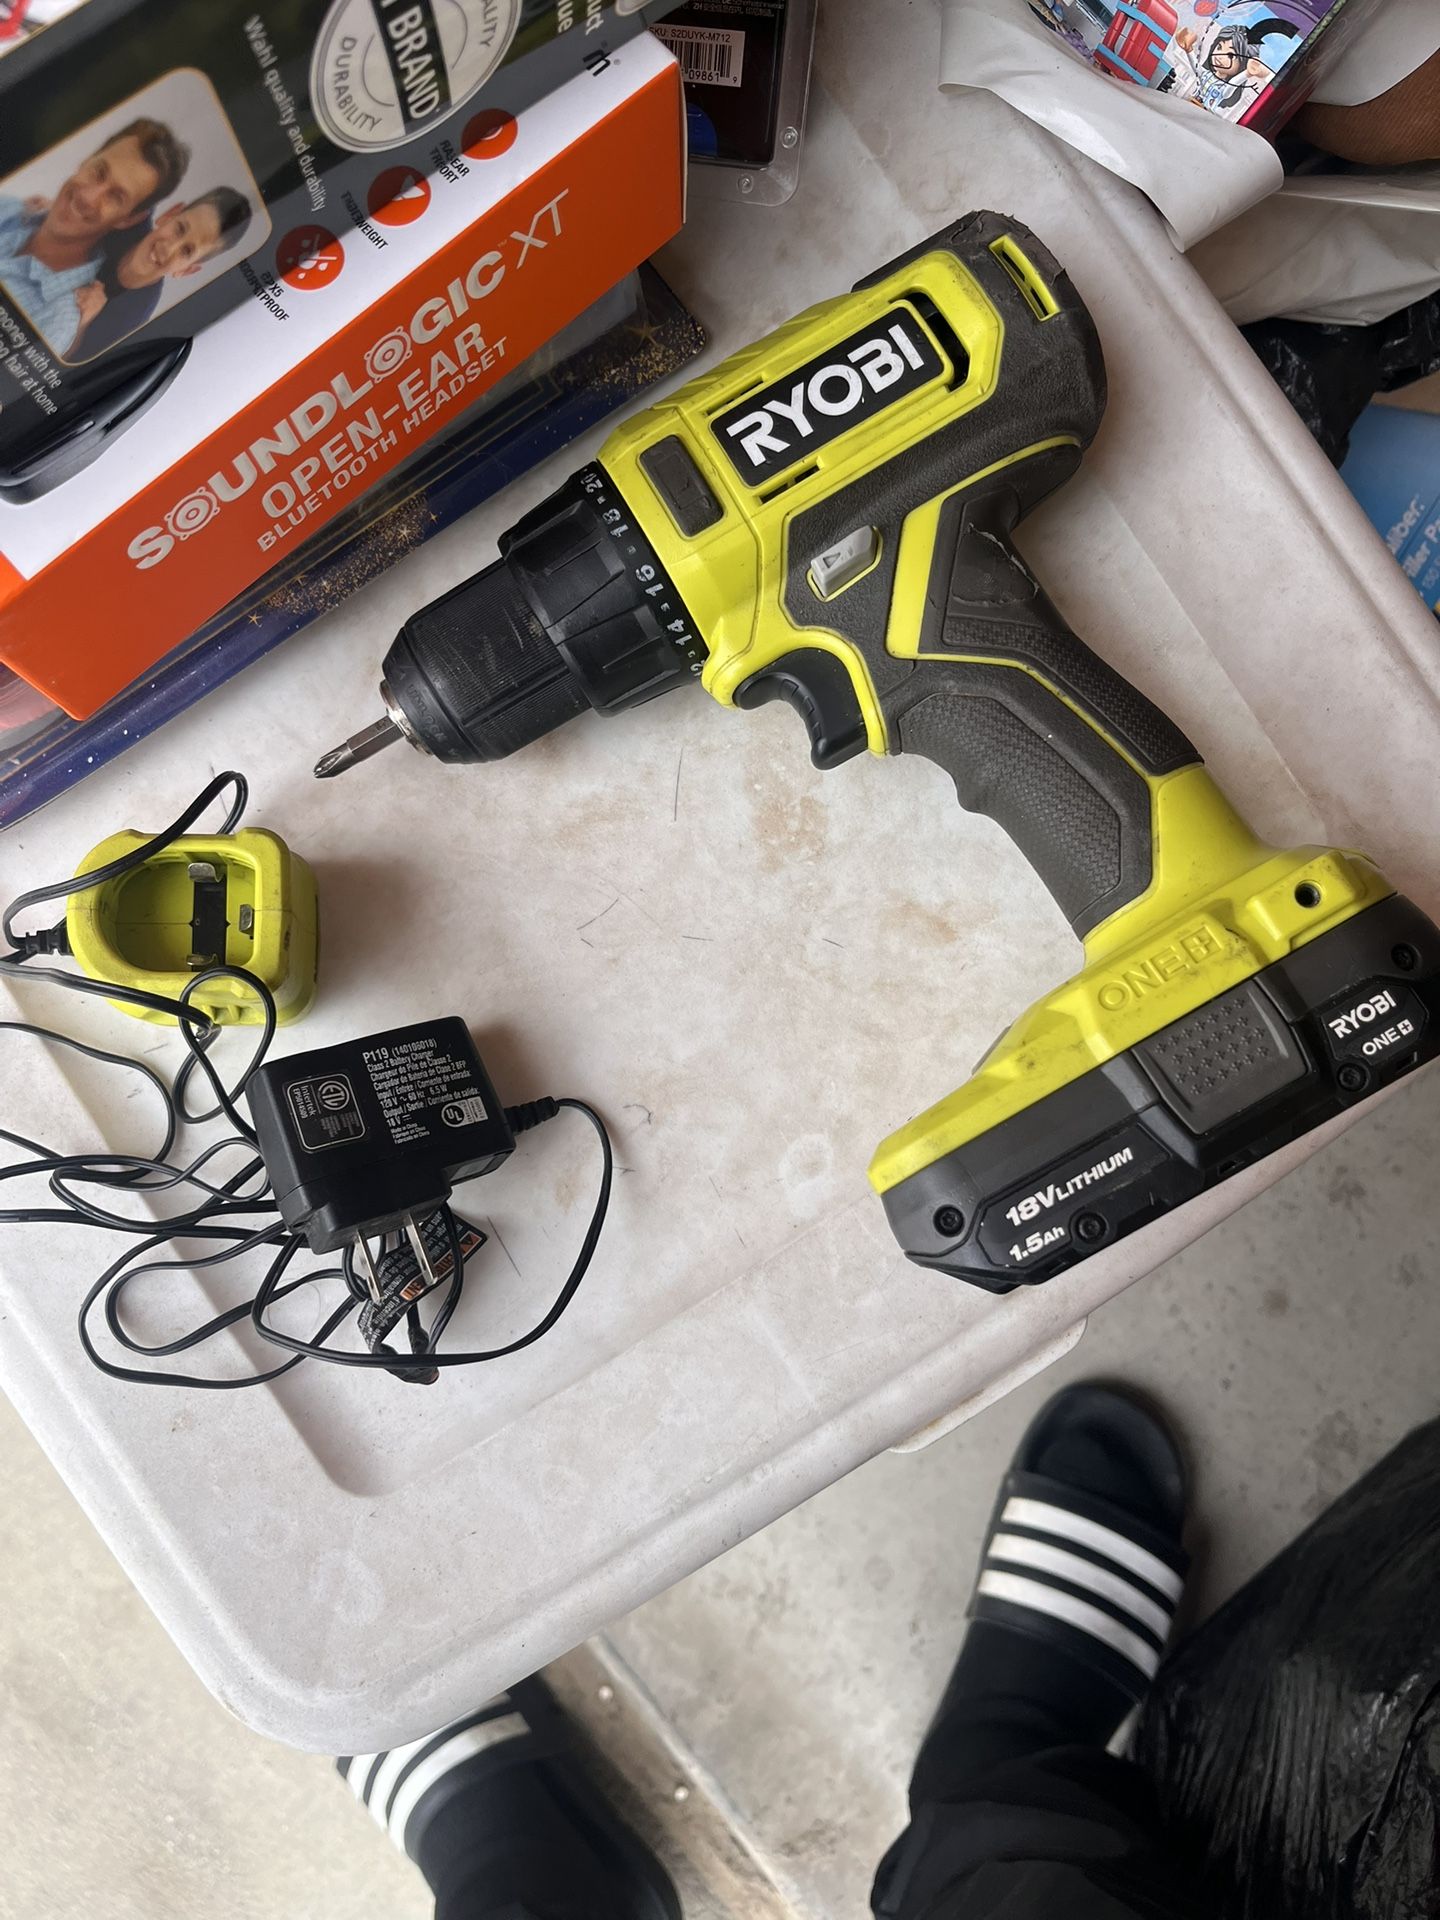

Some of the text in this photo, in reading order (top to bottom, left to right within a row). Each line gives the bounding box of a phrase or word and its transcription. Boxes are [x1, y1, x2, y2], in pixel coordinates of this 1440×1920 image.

[480, 0, 498, 46] ALITY
[334, 36, 382, 132] DURABILITY
[387, 5, 440, 120] BRAND
[244, 15, 326, 213] Wahl quality and durability
[5, 353, 29, 379] hair
[22, 377, 40, 392] at
[32, 385, 58, 416] home
[24, 345, 52, 374] with
[43, 368, 62, 390] the
[726, 324, 925, 467] RYOBI
[261, 323, 487, 519] OPEN-EAR
[257, 336, 508, 552] BLUETOOTH HEADSET
[602, 508, 630, 538] 18
[635, 564, 665, 597] 16
[667, 618, 692, 647] 14
[1329, 990, 1397, 1039] RYOBI
[362, 1047, 389, 1064] P119
[367, 1063, 385, 1073] Class
[389, 1056, 411, 1067] Battery
[410, 1050, 435, 1063] Charger
[300, 1085, 317, 1117] Intertek
[445, 1108, 463, 1121] UL
[1009, 1226, 1065, 1262] 1.5Ah
